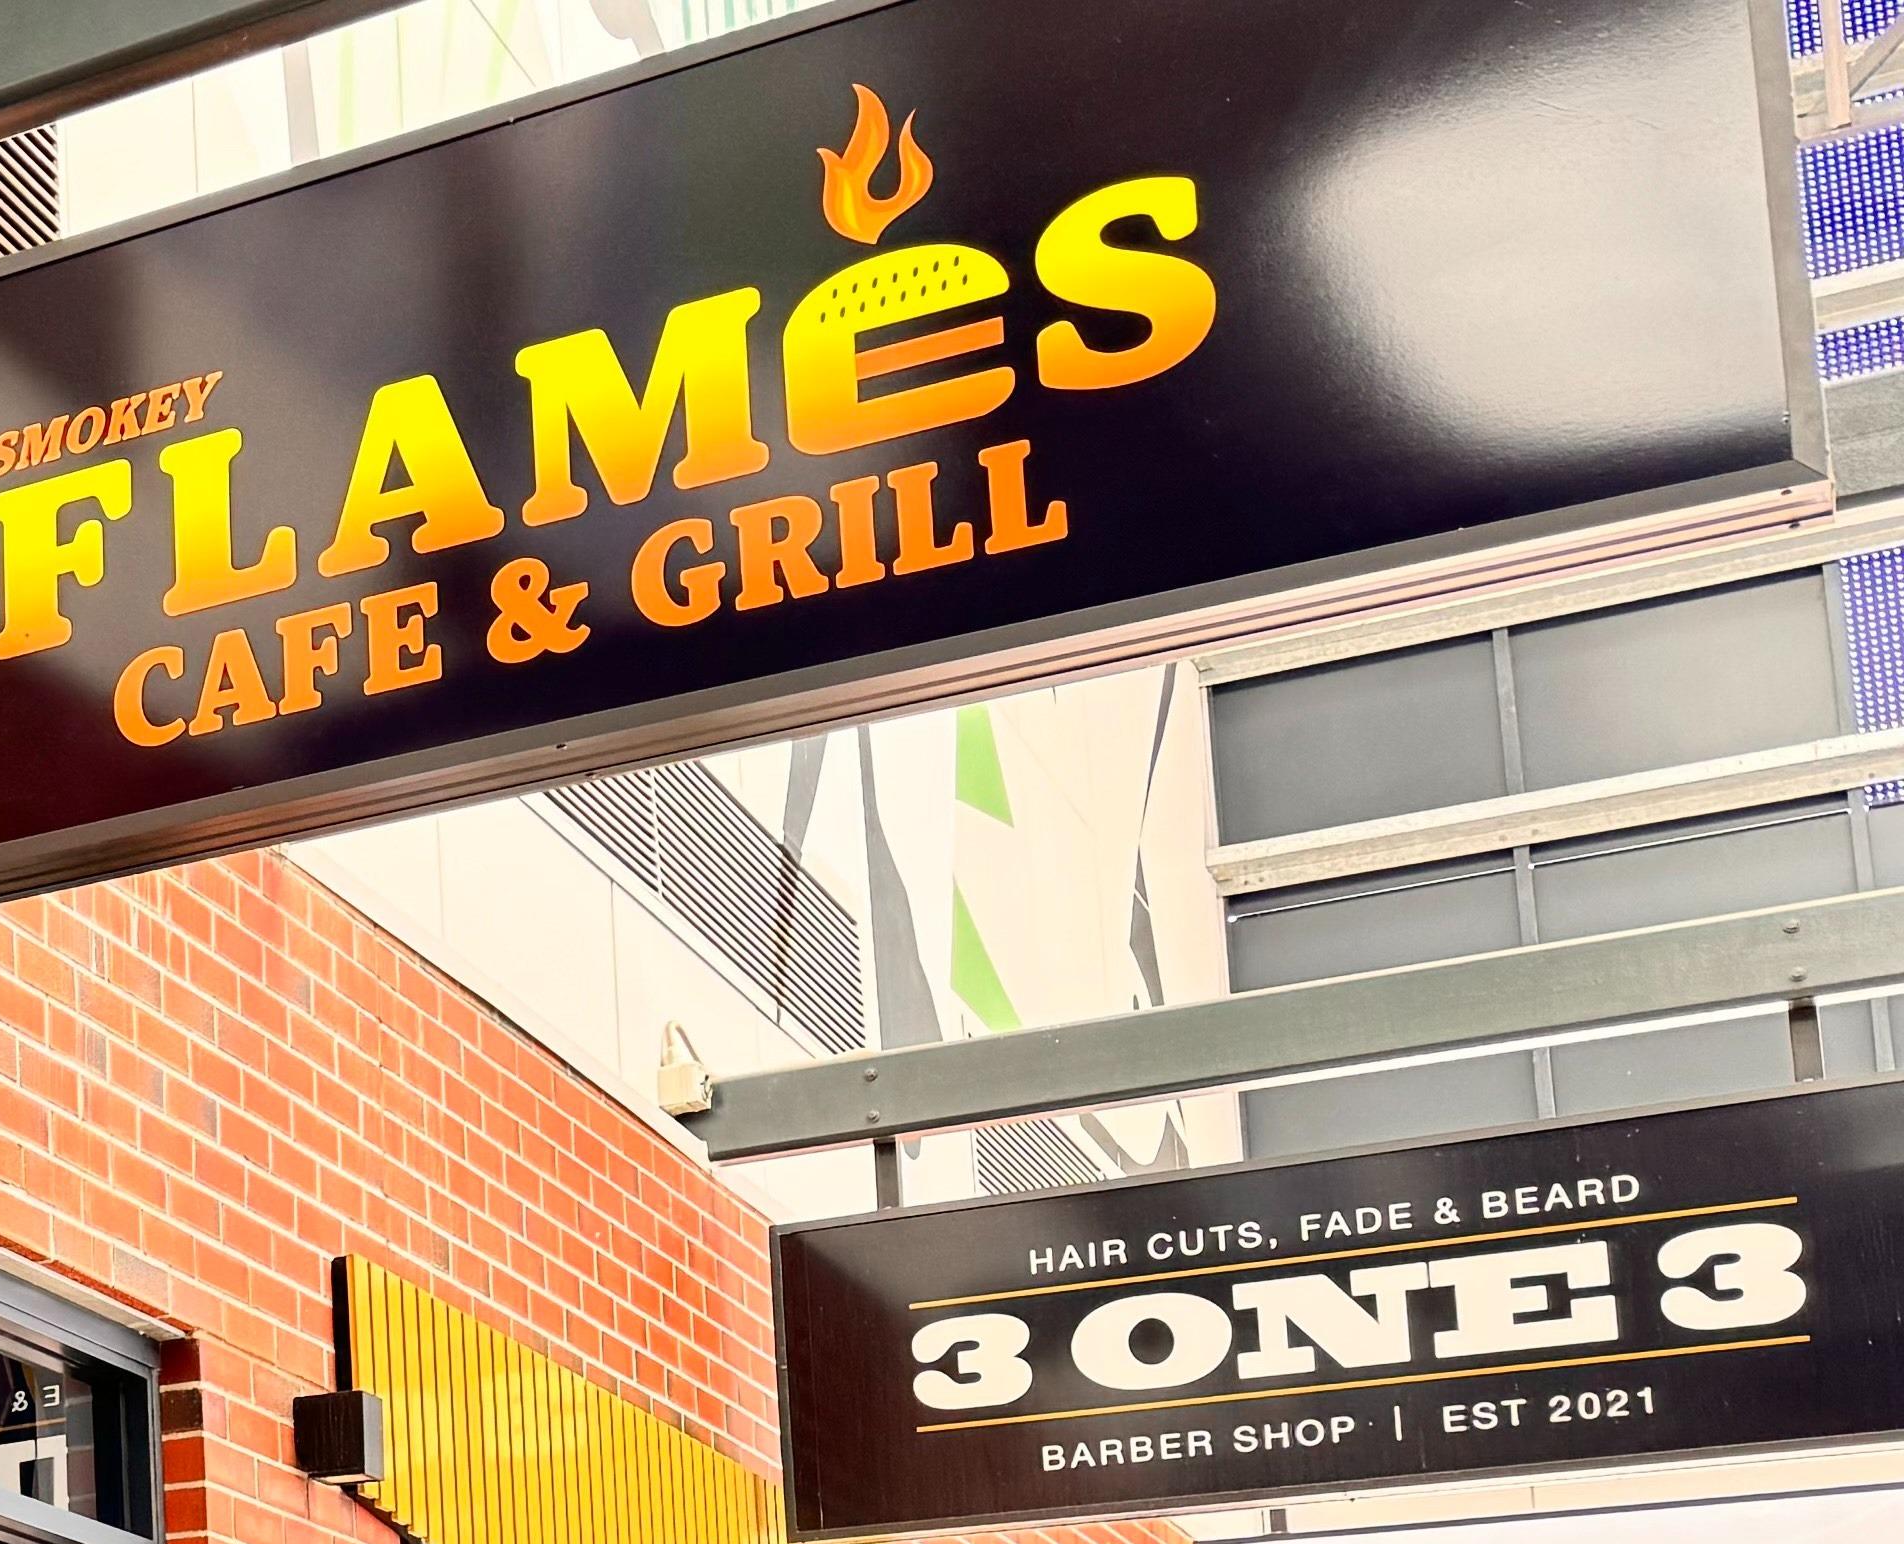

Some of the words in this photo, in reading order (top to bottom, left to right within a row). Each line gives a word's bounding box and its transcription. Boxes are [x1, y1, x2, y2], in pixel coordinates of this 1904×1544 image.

[112, 596, 445, 748] CAFE
[484, 556, 589, 665] &
[629, 437, 1070, 632] GRILL
[1030, 1237, 1129, 1275] HAIR
[1147, 1220, 1279, 1260] CUTS,
[1300, 1199, 1414, 1241] FADE
[1434, 1197, 1460, 1225] &
[1482, 1173, 1641, 1221] BEARD
[912, 1312, 1033, 1410] 3
[1070, 1240, 1620, 1393] ONE
[1657, 1222, 1806, 1330] 3
[1041, 1429, 1214, 1472] BARBER
[1233, 1416, 1357, 1454] SHOP
[1442, 1398, 1525, 1433] EST
[1549, 1387, 1656, 1424] 2021
